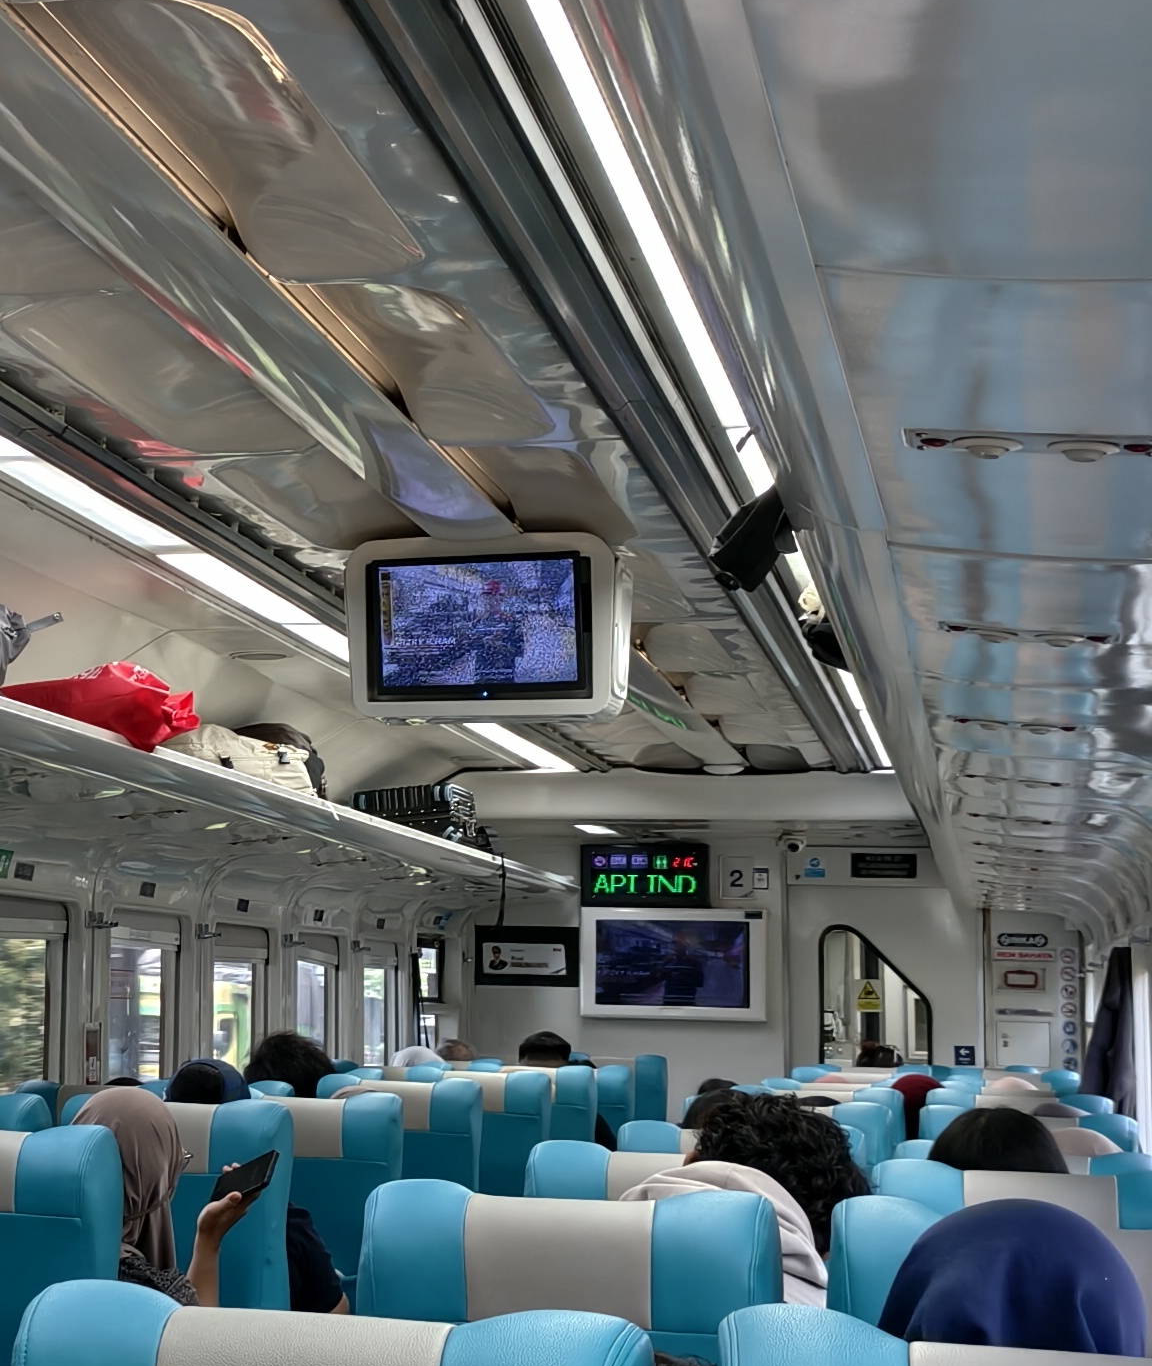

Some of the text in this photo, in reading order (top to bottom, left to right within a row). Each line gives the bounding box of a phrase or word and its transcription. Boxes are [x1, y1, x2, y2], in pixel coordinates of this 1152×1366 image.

[594, 874, 696, 894] API IND
[729, 870, 744, 888] 2
